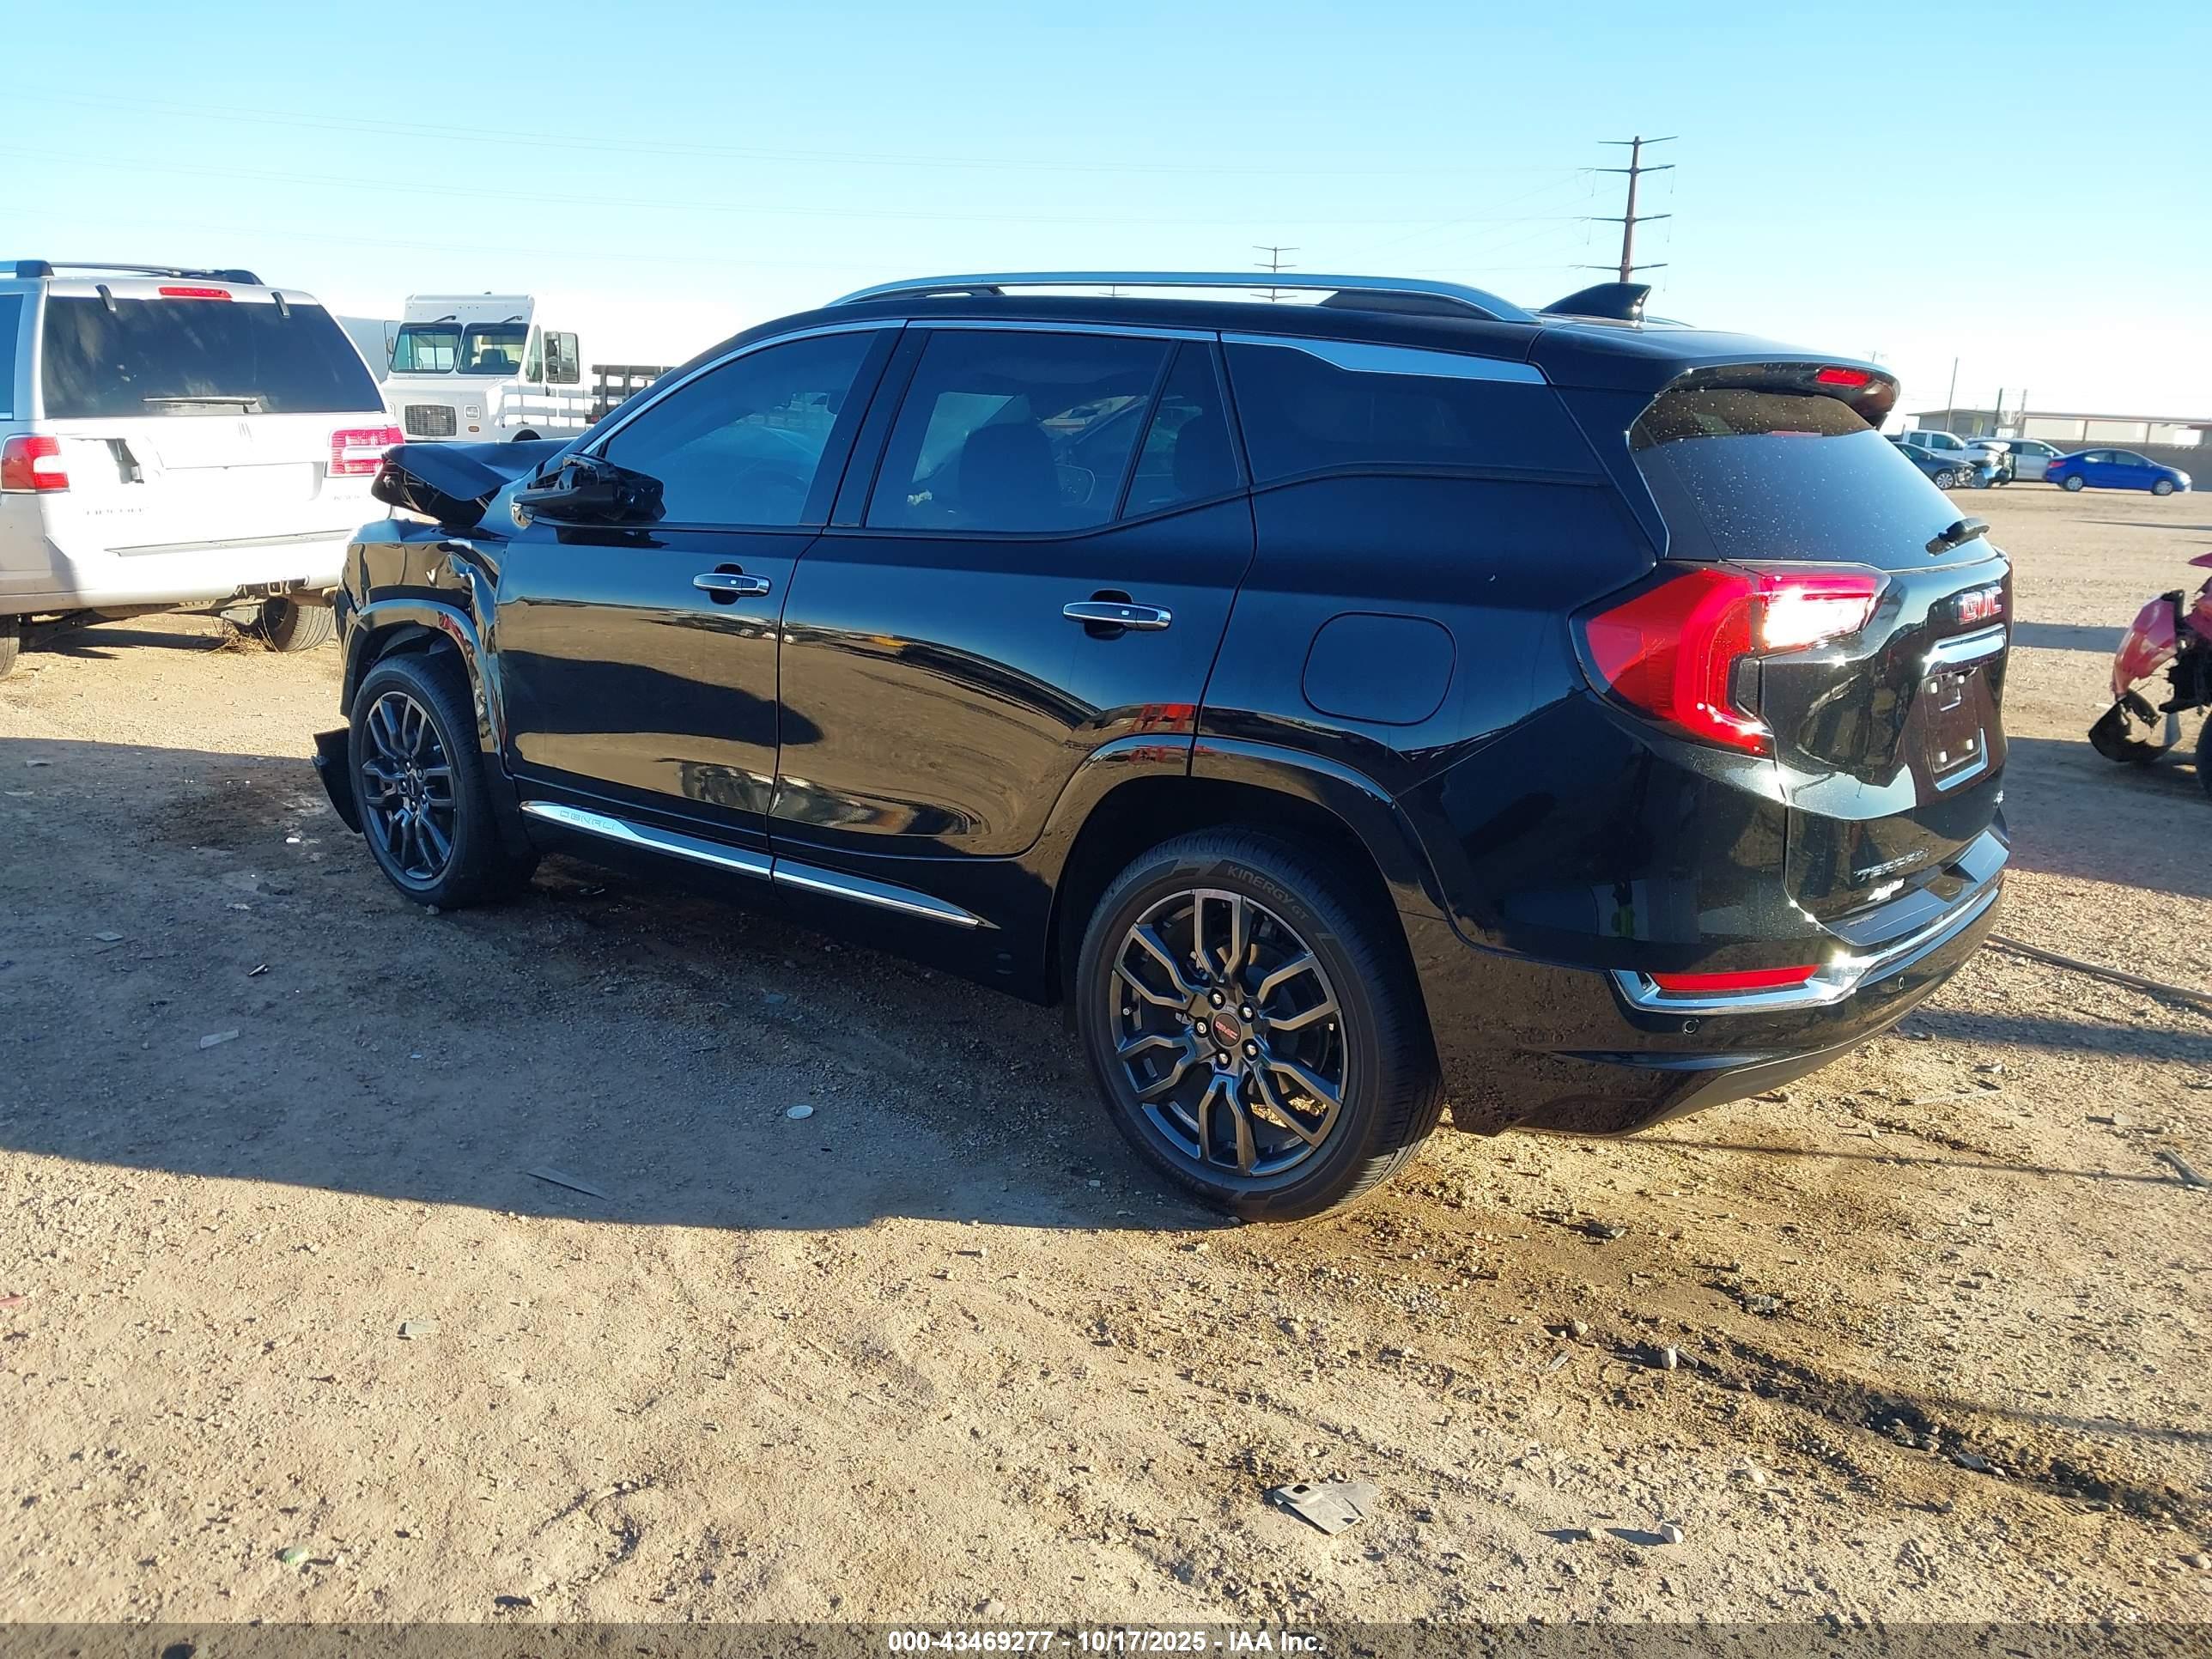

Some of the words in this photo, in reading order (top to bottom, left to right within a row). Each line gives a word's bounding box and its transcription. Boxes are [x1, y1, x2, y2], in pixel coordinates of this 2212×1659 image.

[1959, 586, 2002, 624] GMC
[559, 810, 616, 831] DENALI
[1227, 865, 1293, 903] KINERGY
[1291, 904, 1310, 921] GT
[1215, 1020, 1238, 1040] GMC
